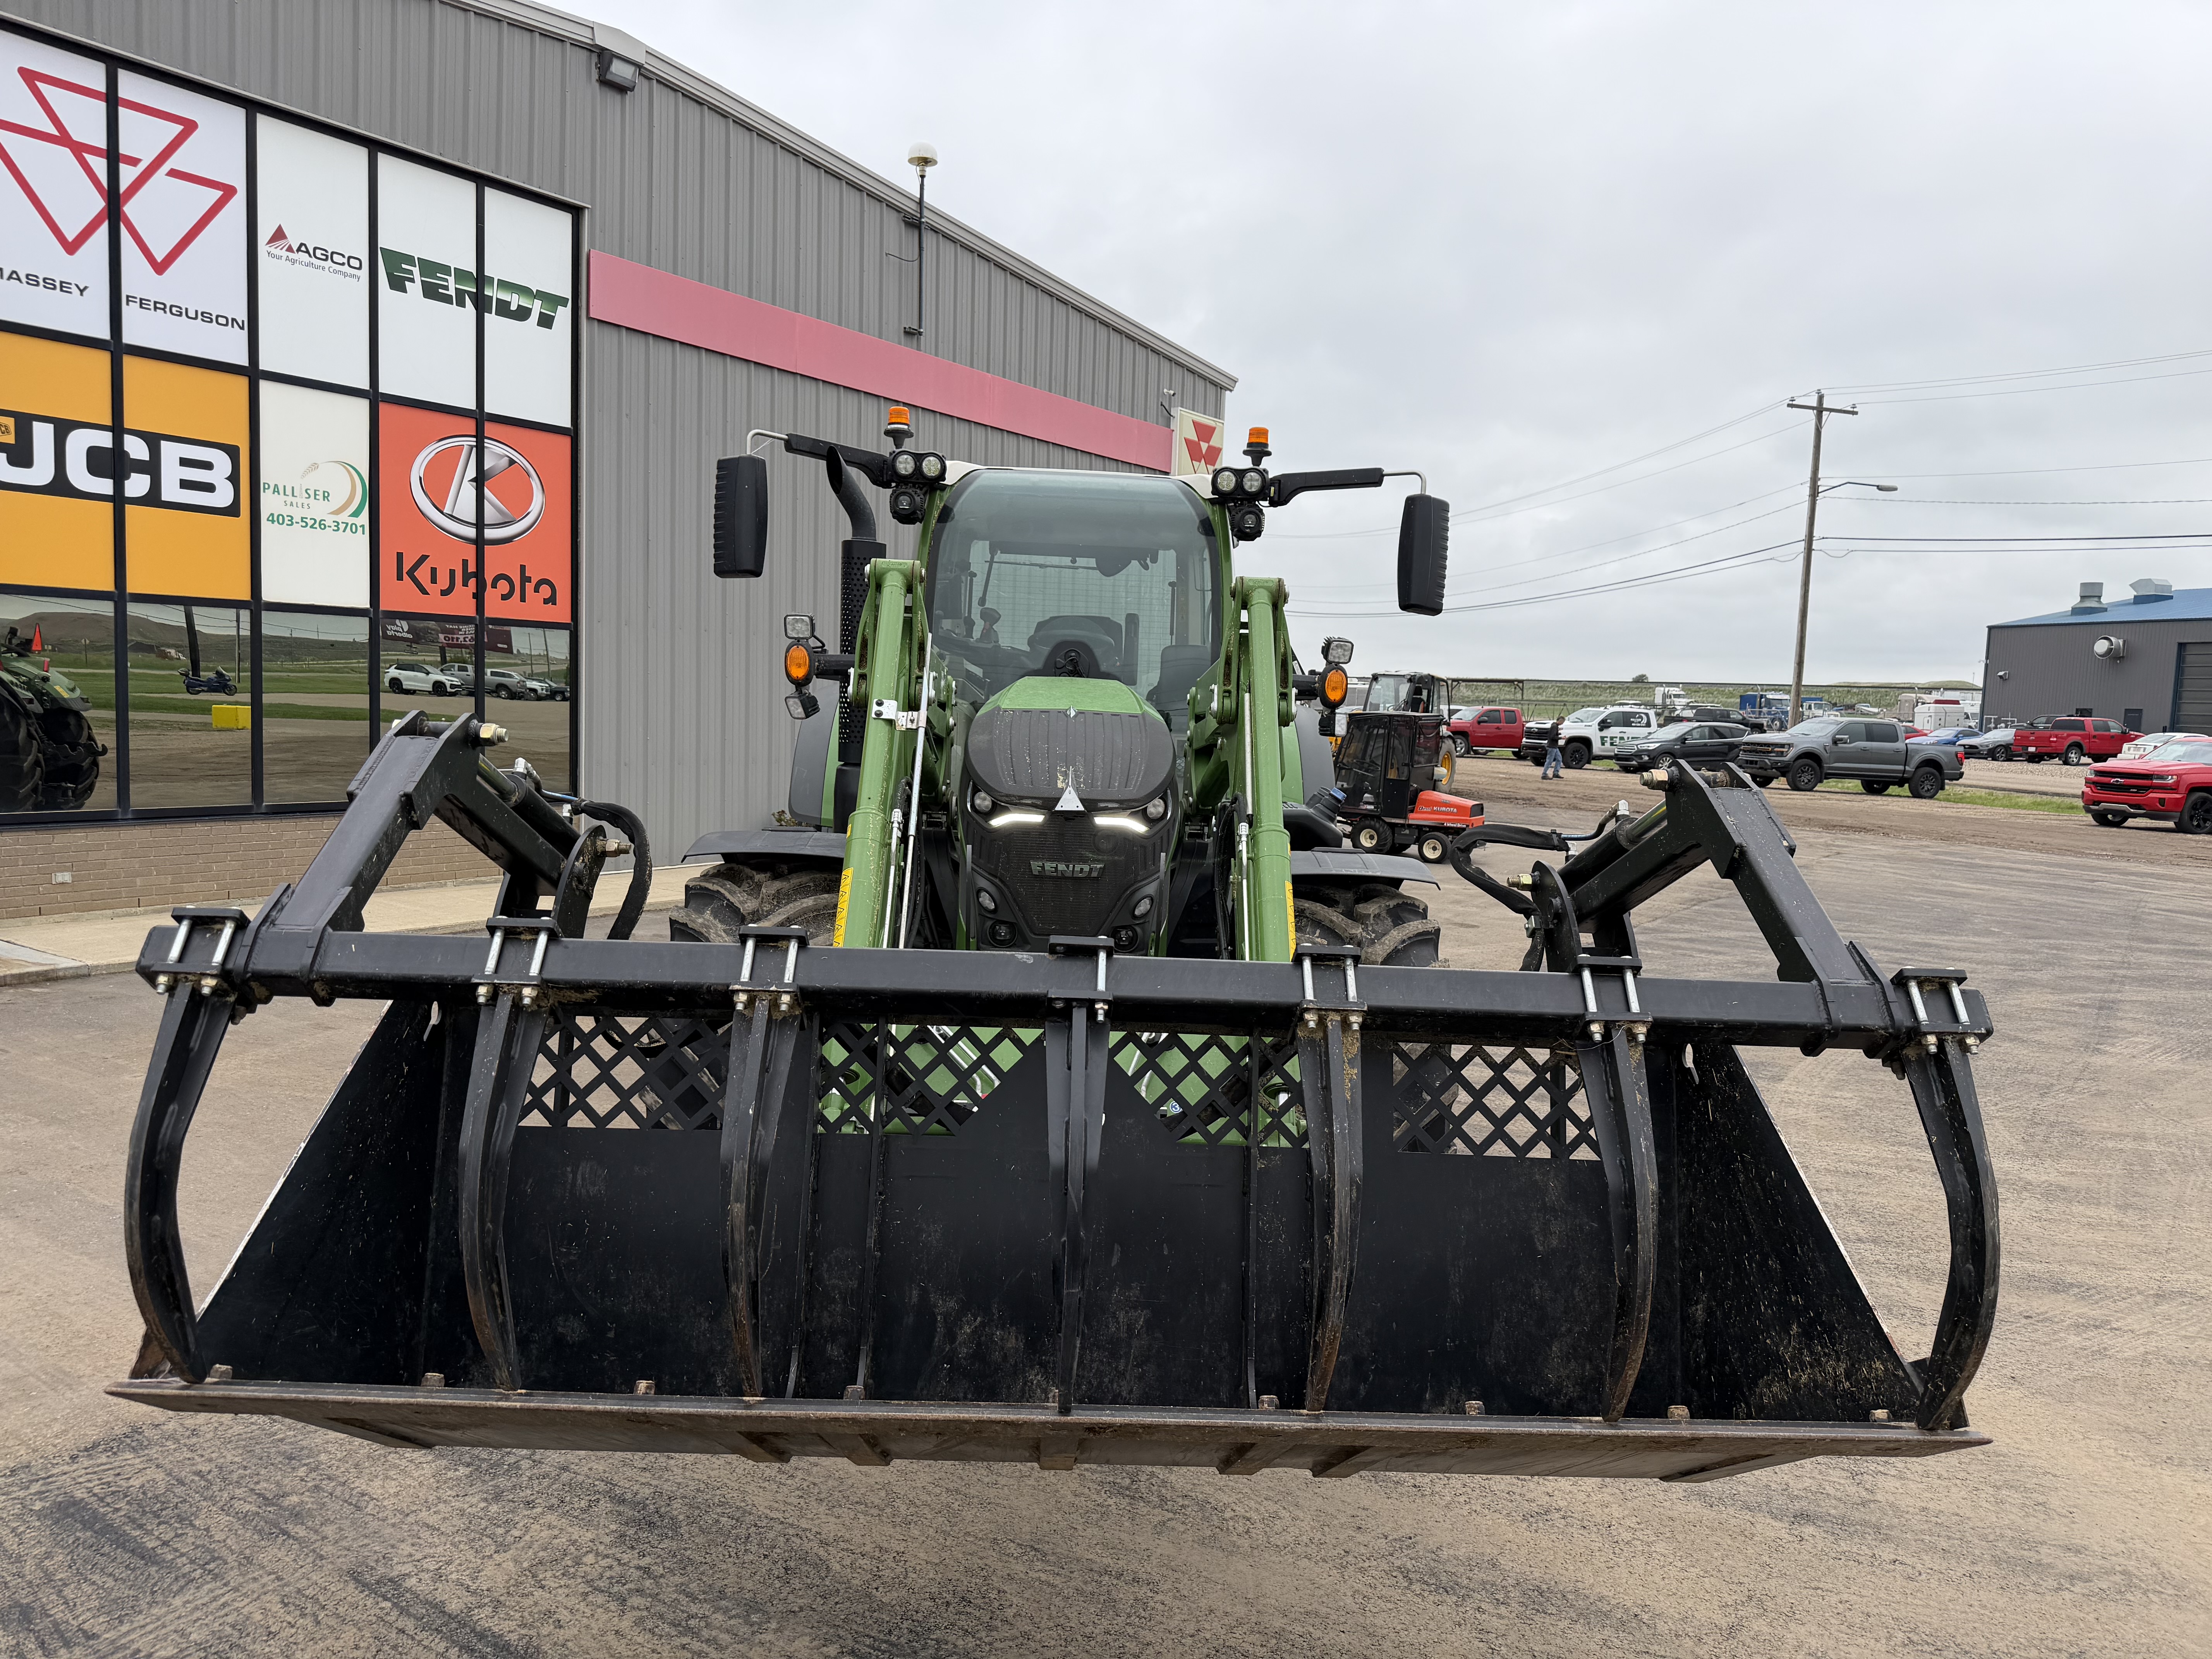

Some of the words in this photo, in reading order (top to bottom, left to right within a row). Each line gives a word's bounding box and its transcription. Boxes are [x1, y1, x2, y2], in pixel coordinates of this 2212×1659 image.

[266, 250, 283, 260] Your
[285, 255, 326, 271] Agriculture
[328, 266, 361, 282] Company
[295, 242, 362, 270] AGCO
[0, 267, 89, 297] ASSEY
[126, 294, 245, 331] FERGUSON
[380, 247, 569, 330] FENDT
[0, 424, 10, 434] CB
[0, 421, 234, 508] JCB
[263, 482, 330, 502] PALLISER
[284, 500, 311, 509] SALES
[266, 513, 365, 535] 403-526-3701
[396, 551, 557, 606] Kubota
[1030, 861, 1104, 878] FENDT
[1172, 1102, 1180, 1111] 3
